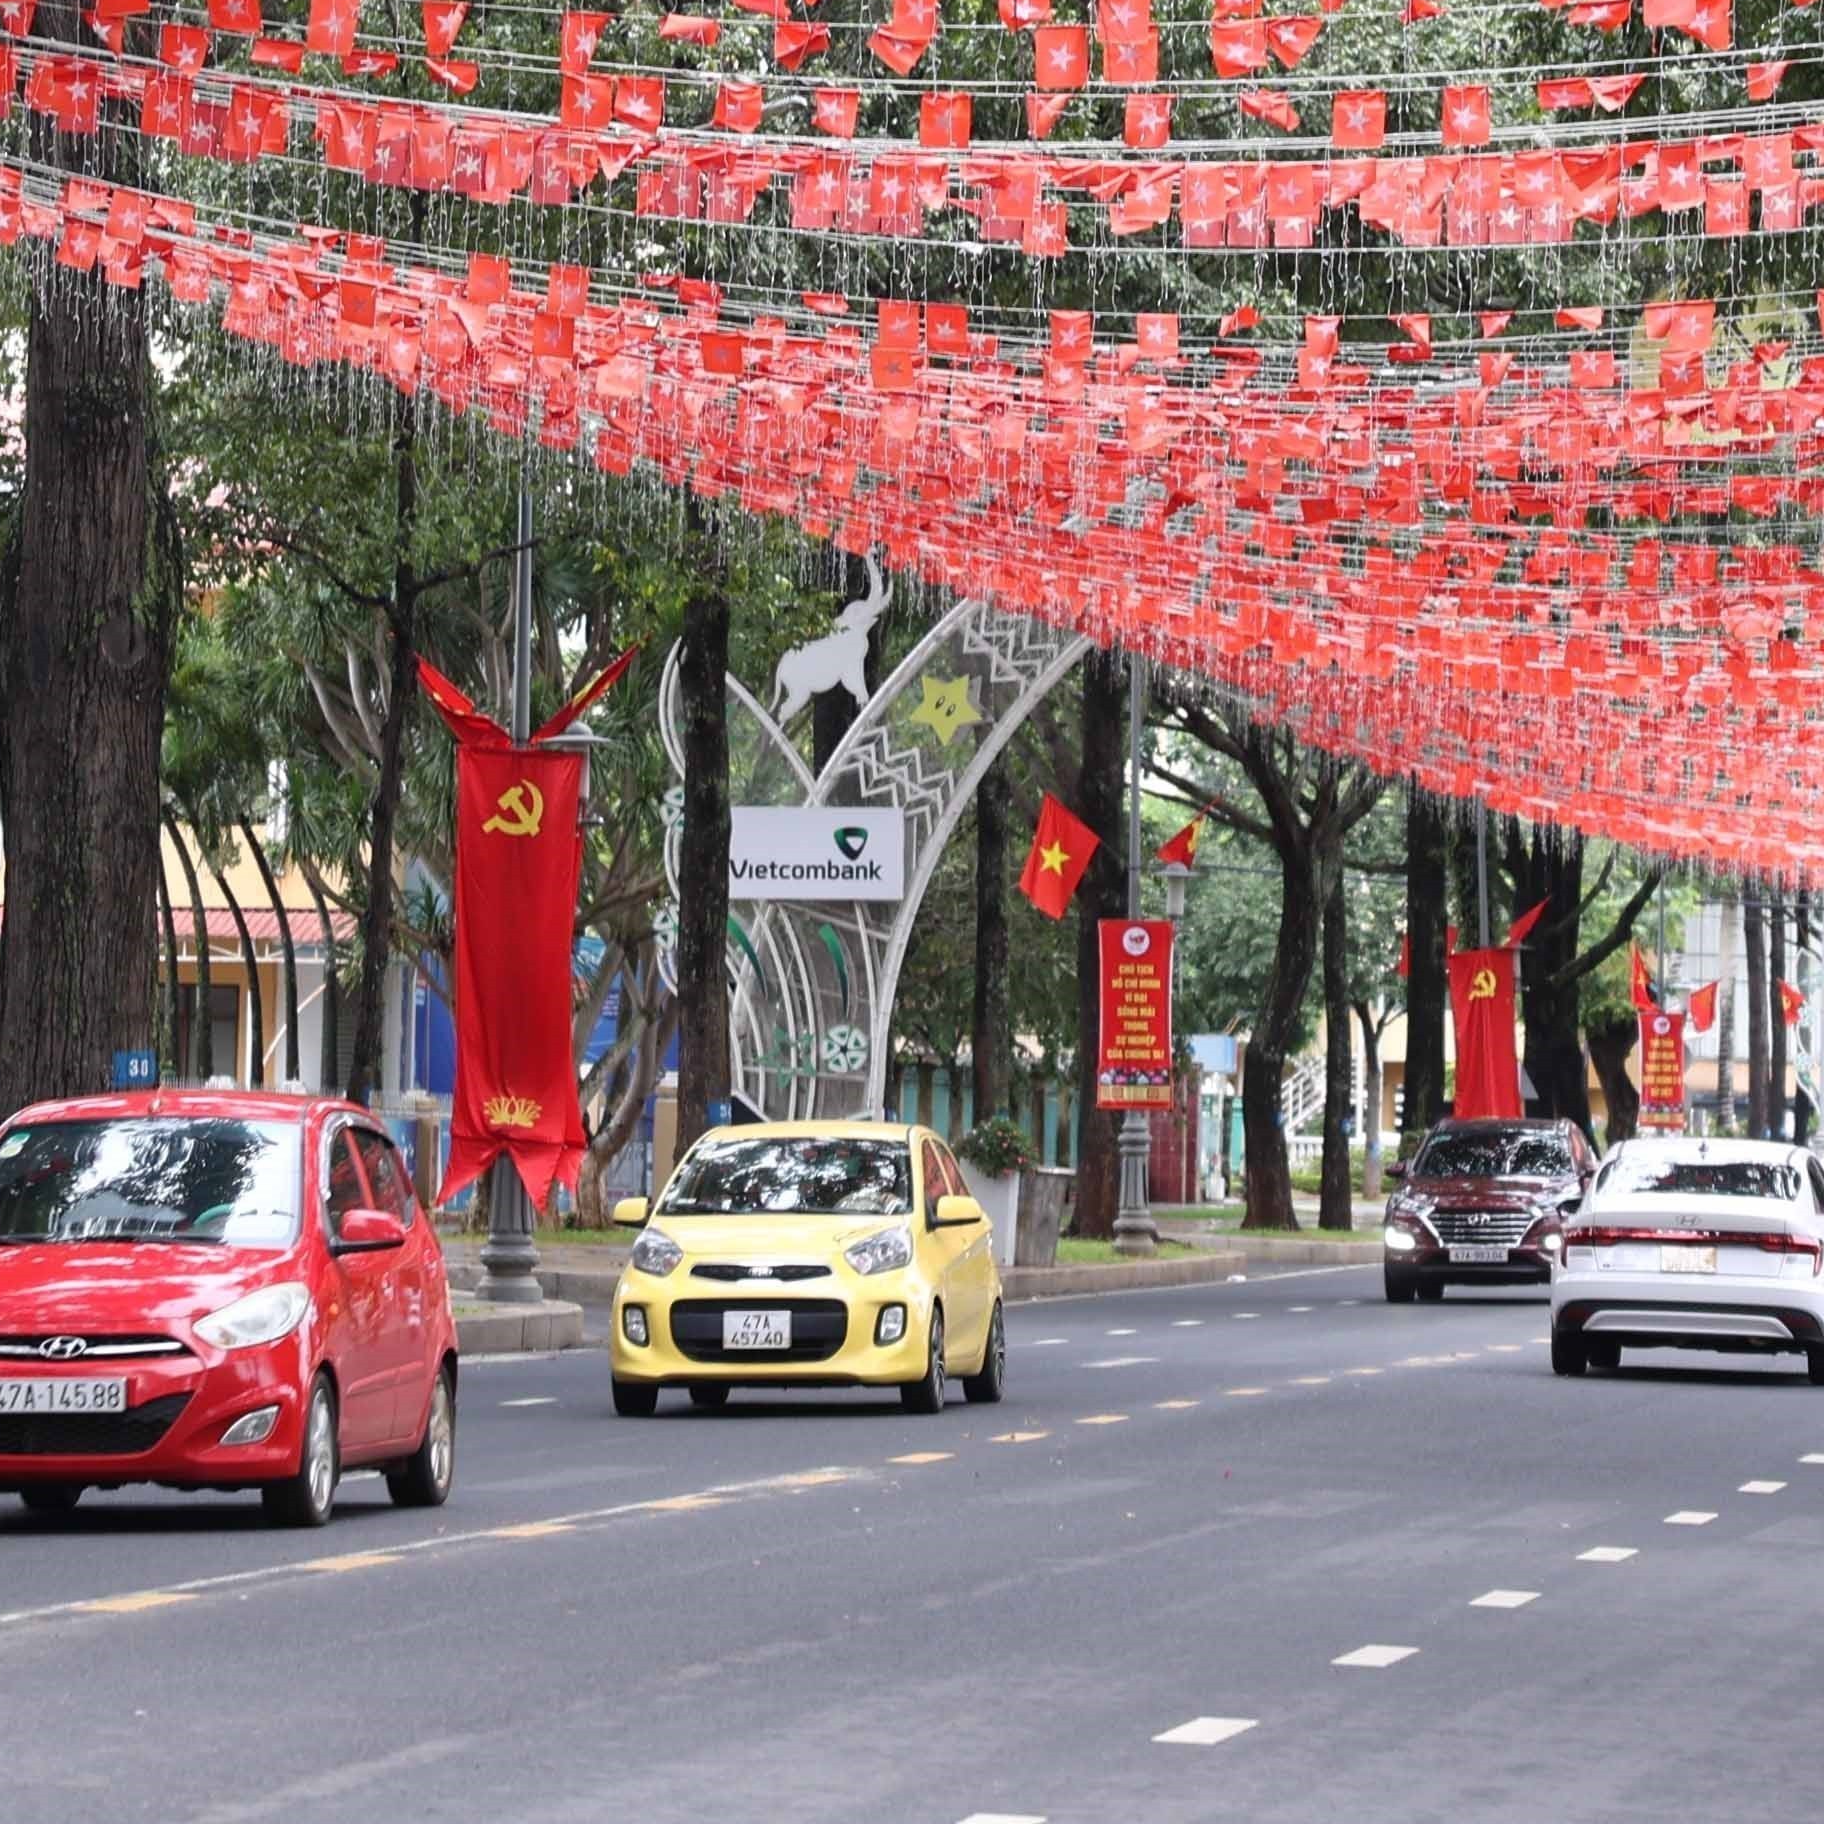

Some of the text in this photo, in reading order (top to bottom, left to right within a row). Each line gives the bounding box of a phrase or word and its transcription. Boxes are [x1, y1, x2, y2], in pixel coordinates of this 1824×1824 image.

[729, 858, 882, 880] Vietcombank
[129, 1059, 149, 1078] 30
[742, 1314, 770, 1330] 47A
